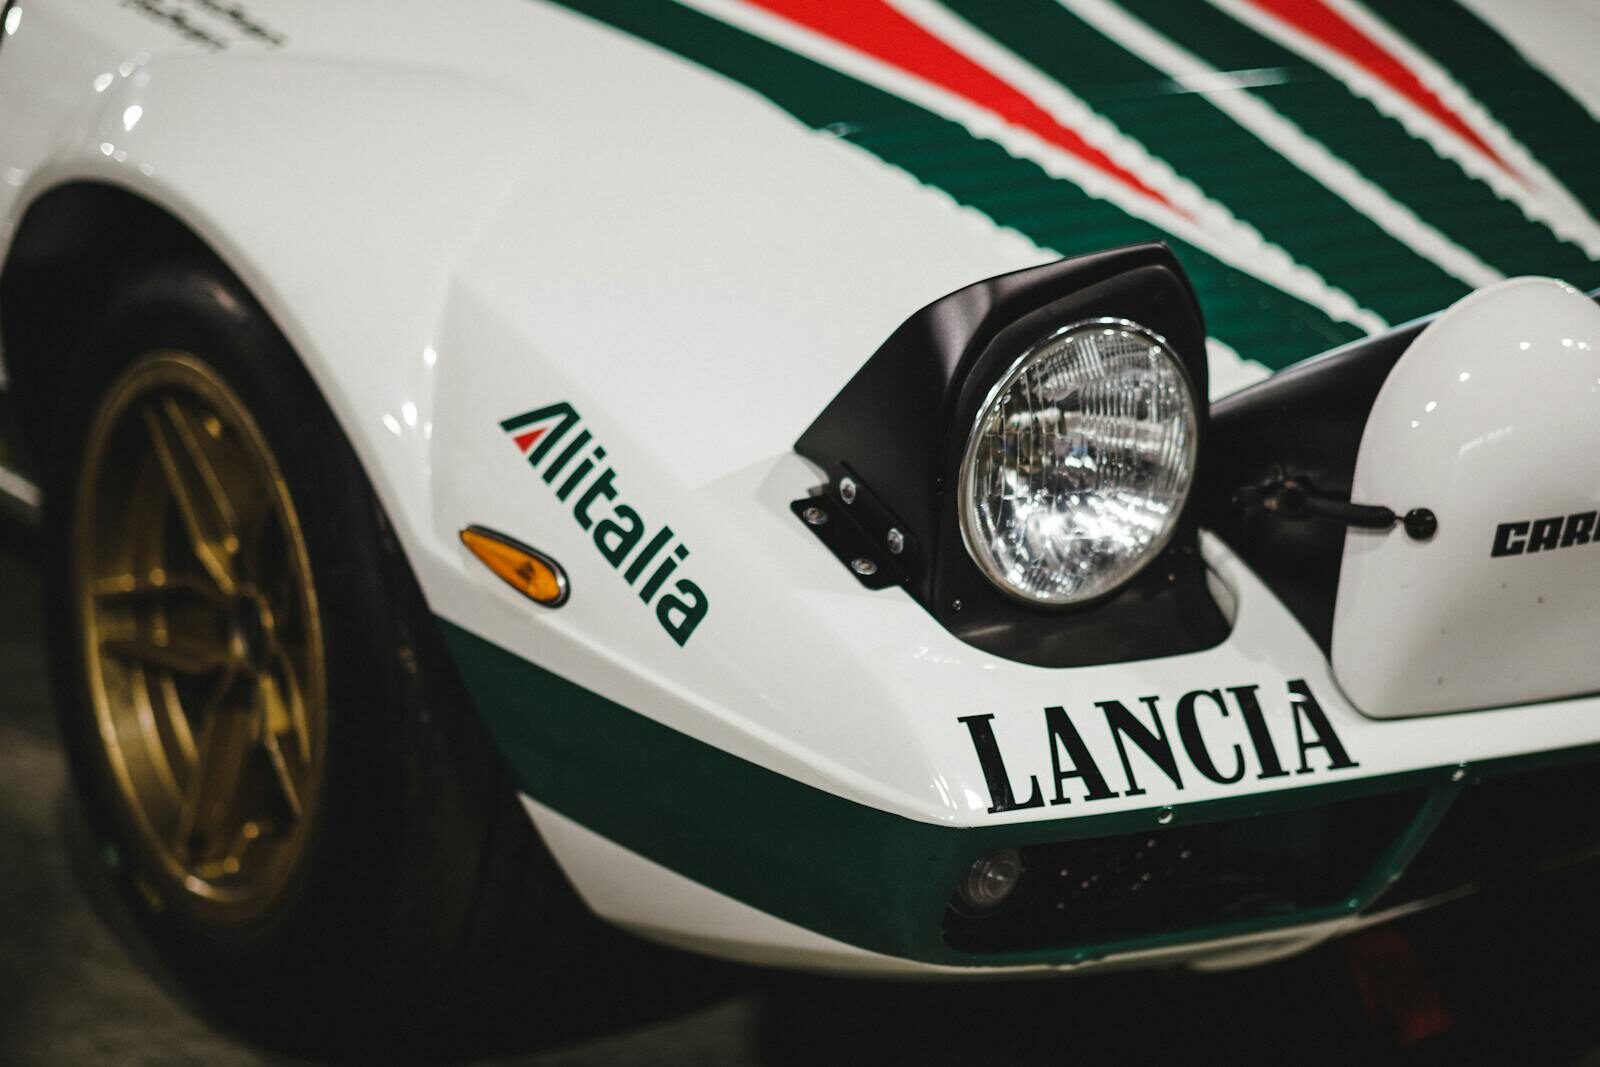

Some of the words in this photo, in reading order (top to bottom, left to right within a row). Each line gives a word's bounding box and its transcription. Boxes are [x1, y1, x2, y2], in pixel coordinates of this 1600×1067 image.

[499, 401, 709, 648] Alitalia
[1490, 510, 1600, 558] CAR
[957, 679, 1360, 814] LANCIA
